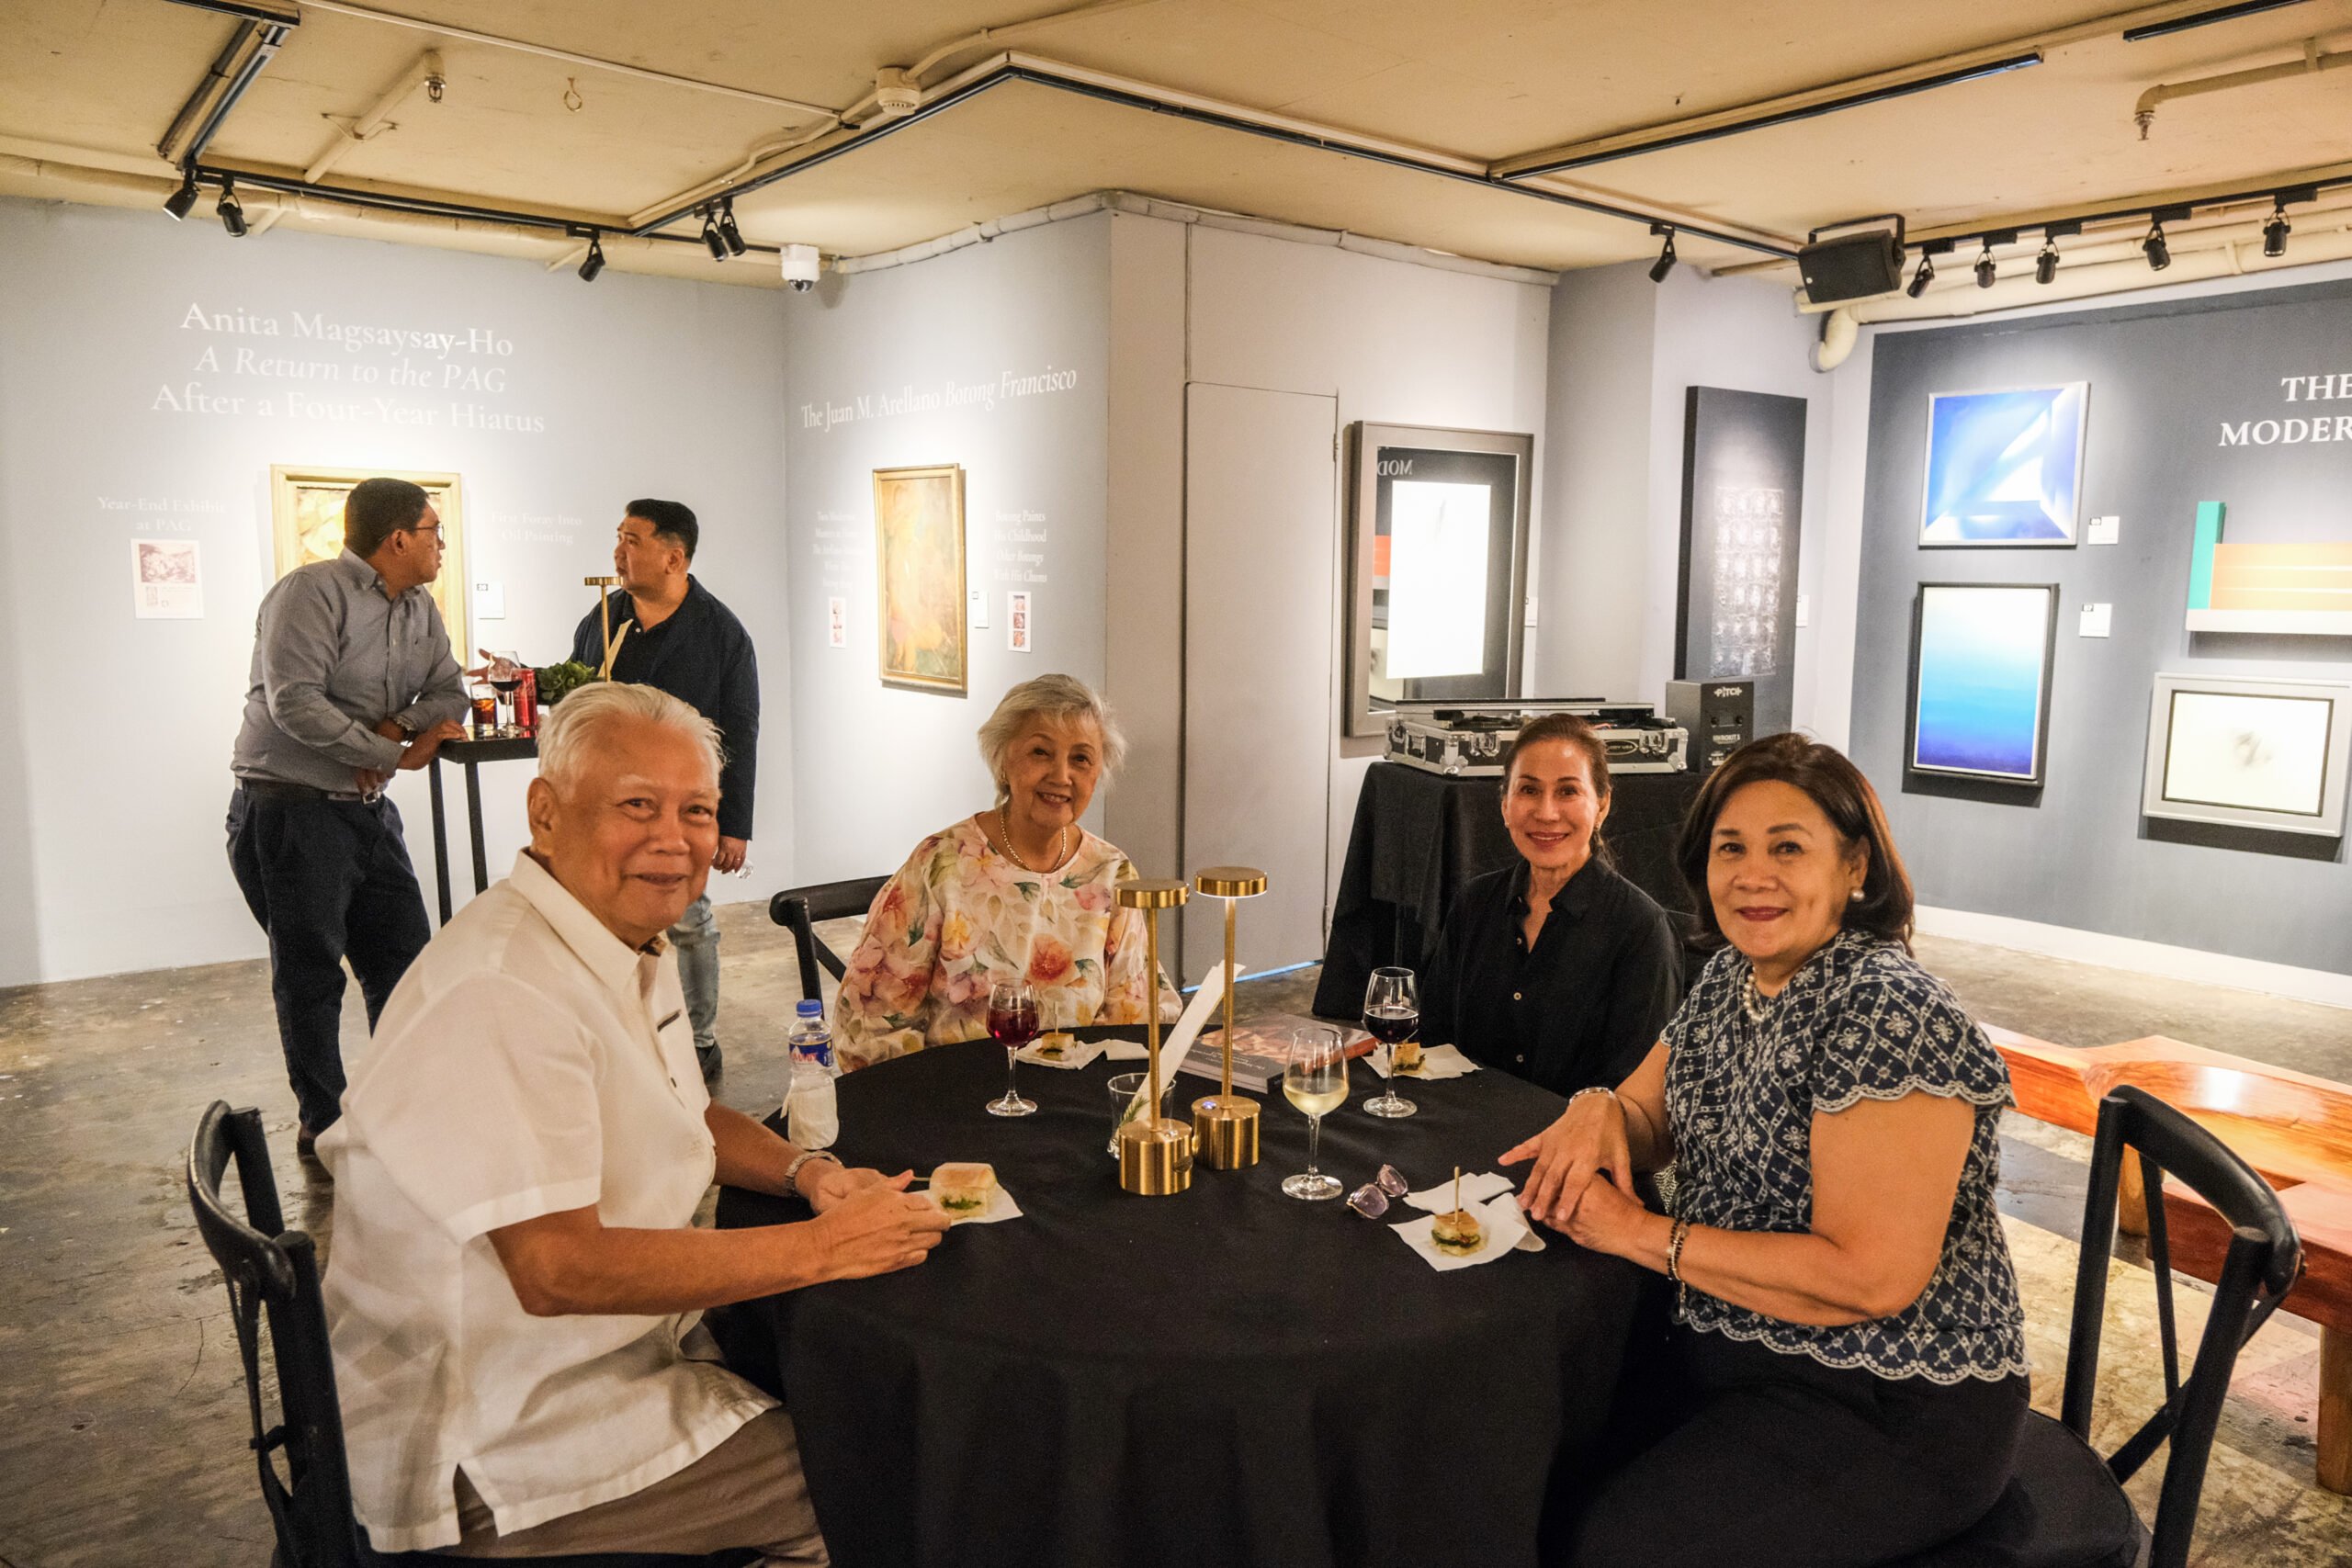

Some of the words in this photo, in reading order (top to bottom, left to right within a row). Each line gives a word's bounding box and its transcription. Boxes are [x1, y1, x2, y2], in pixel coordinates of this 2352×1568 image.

[180, 301, 280, 336] Anita
[291, 310, 514, 359] Magsaysay-Ho
[194, 344, 220, 373] A
[235, 347, 339, 381] Return
[351, 363, 379, 385] to
[389, 358, 433, 389] the
[442, 364, 506, 393] PAG
[2280, 373, 2352, 402] THE
[150, 381, 246, 415] After
[257, 398, 275, 417] a
[286, 392, 438, 428] Four-Year
[448, 401, 546, 434] Hiatus
[801, 403, 822, 428] The
[824, 401, 854, 433] Juan
[856, 394, 874, 419] M.
[877, 385, 940, 417] Arellano
[945, 381, 995, 411] Botong
[1000, 365, 1077, 399] Francisco
[2218, 415, 2352, 446] MODER
[96, 496, 167, 512] Year-End
[155, 518, 192, 531] PAG
[558, 513, 582, 525] Into
[1023, 509, 1046, 523] Paints
[525, 530, 574, 546] Painting
[1008, 528, 1046, 543] Childhood
